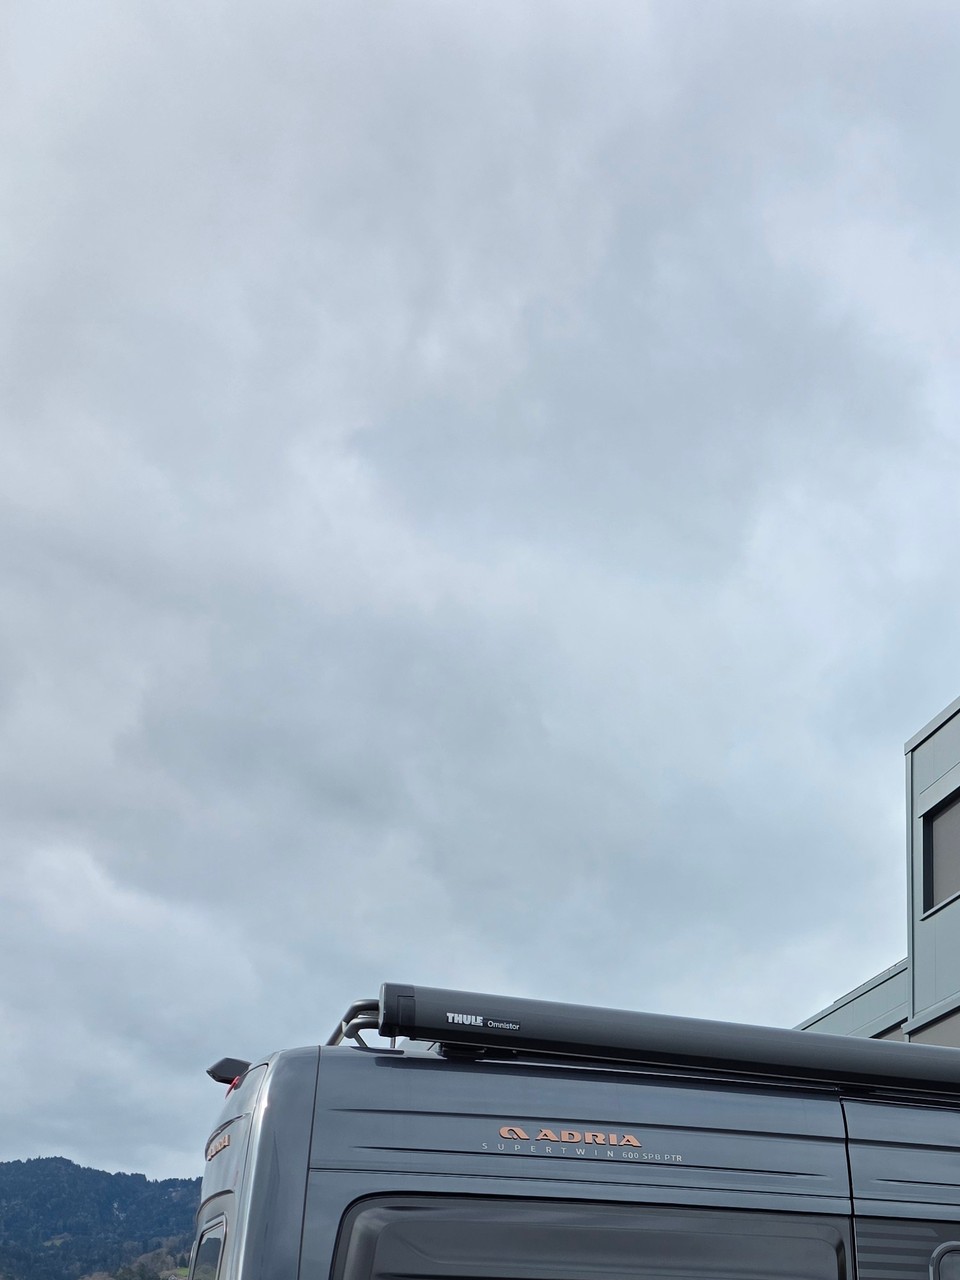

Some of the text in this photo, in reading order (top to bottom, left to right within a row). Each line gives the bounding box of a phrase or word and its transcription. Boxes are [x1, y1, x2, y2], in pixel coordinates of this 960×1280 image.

[446, 1012, 520, 1031] THULE Omnistor
[535, 1128, 643, 1148] ADRIA
[481, 1142, 614, 1158] SUPERTWIN
[622, 1151, 639, 1160] 600
[664, 1153, 683, 1162] PTR
